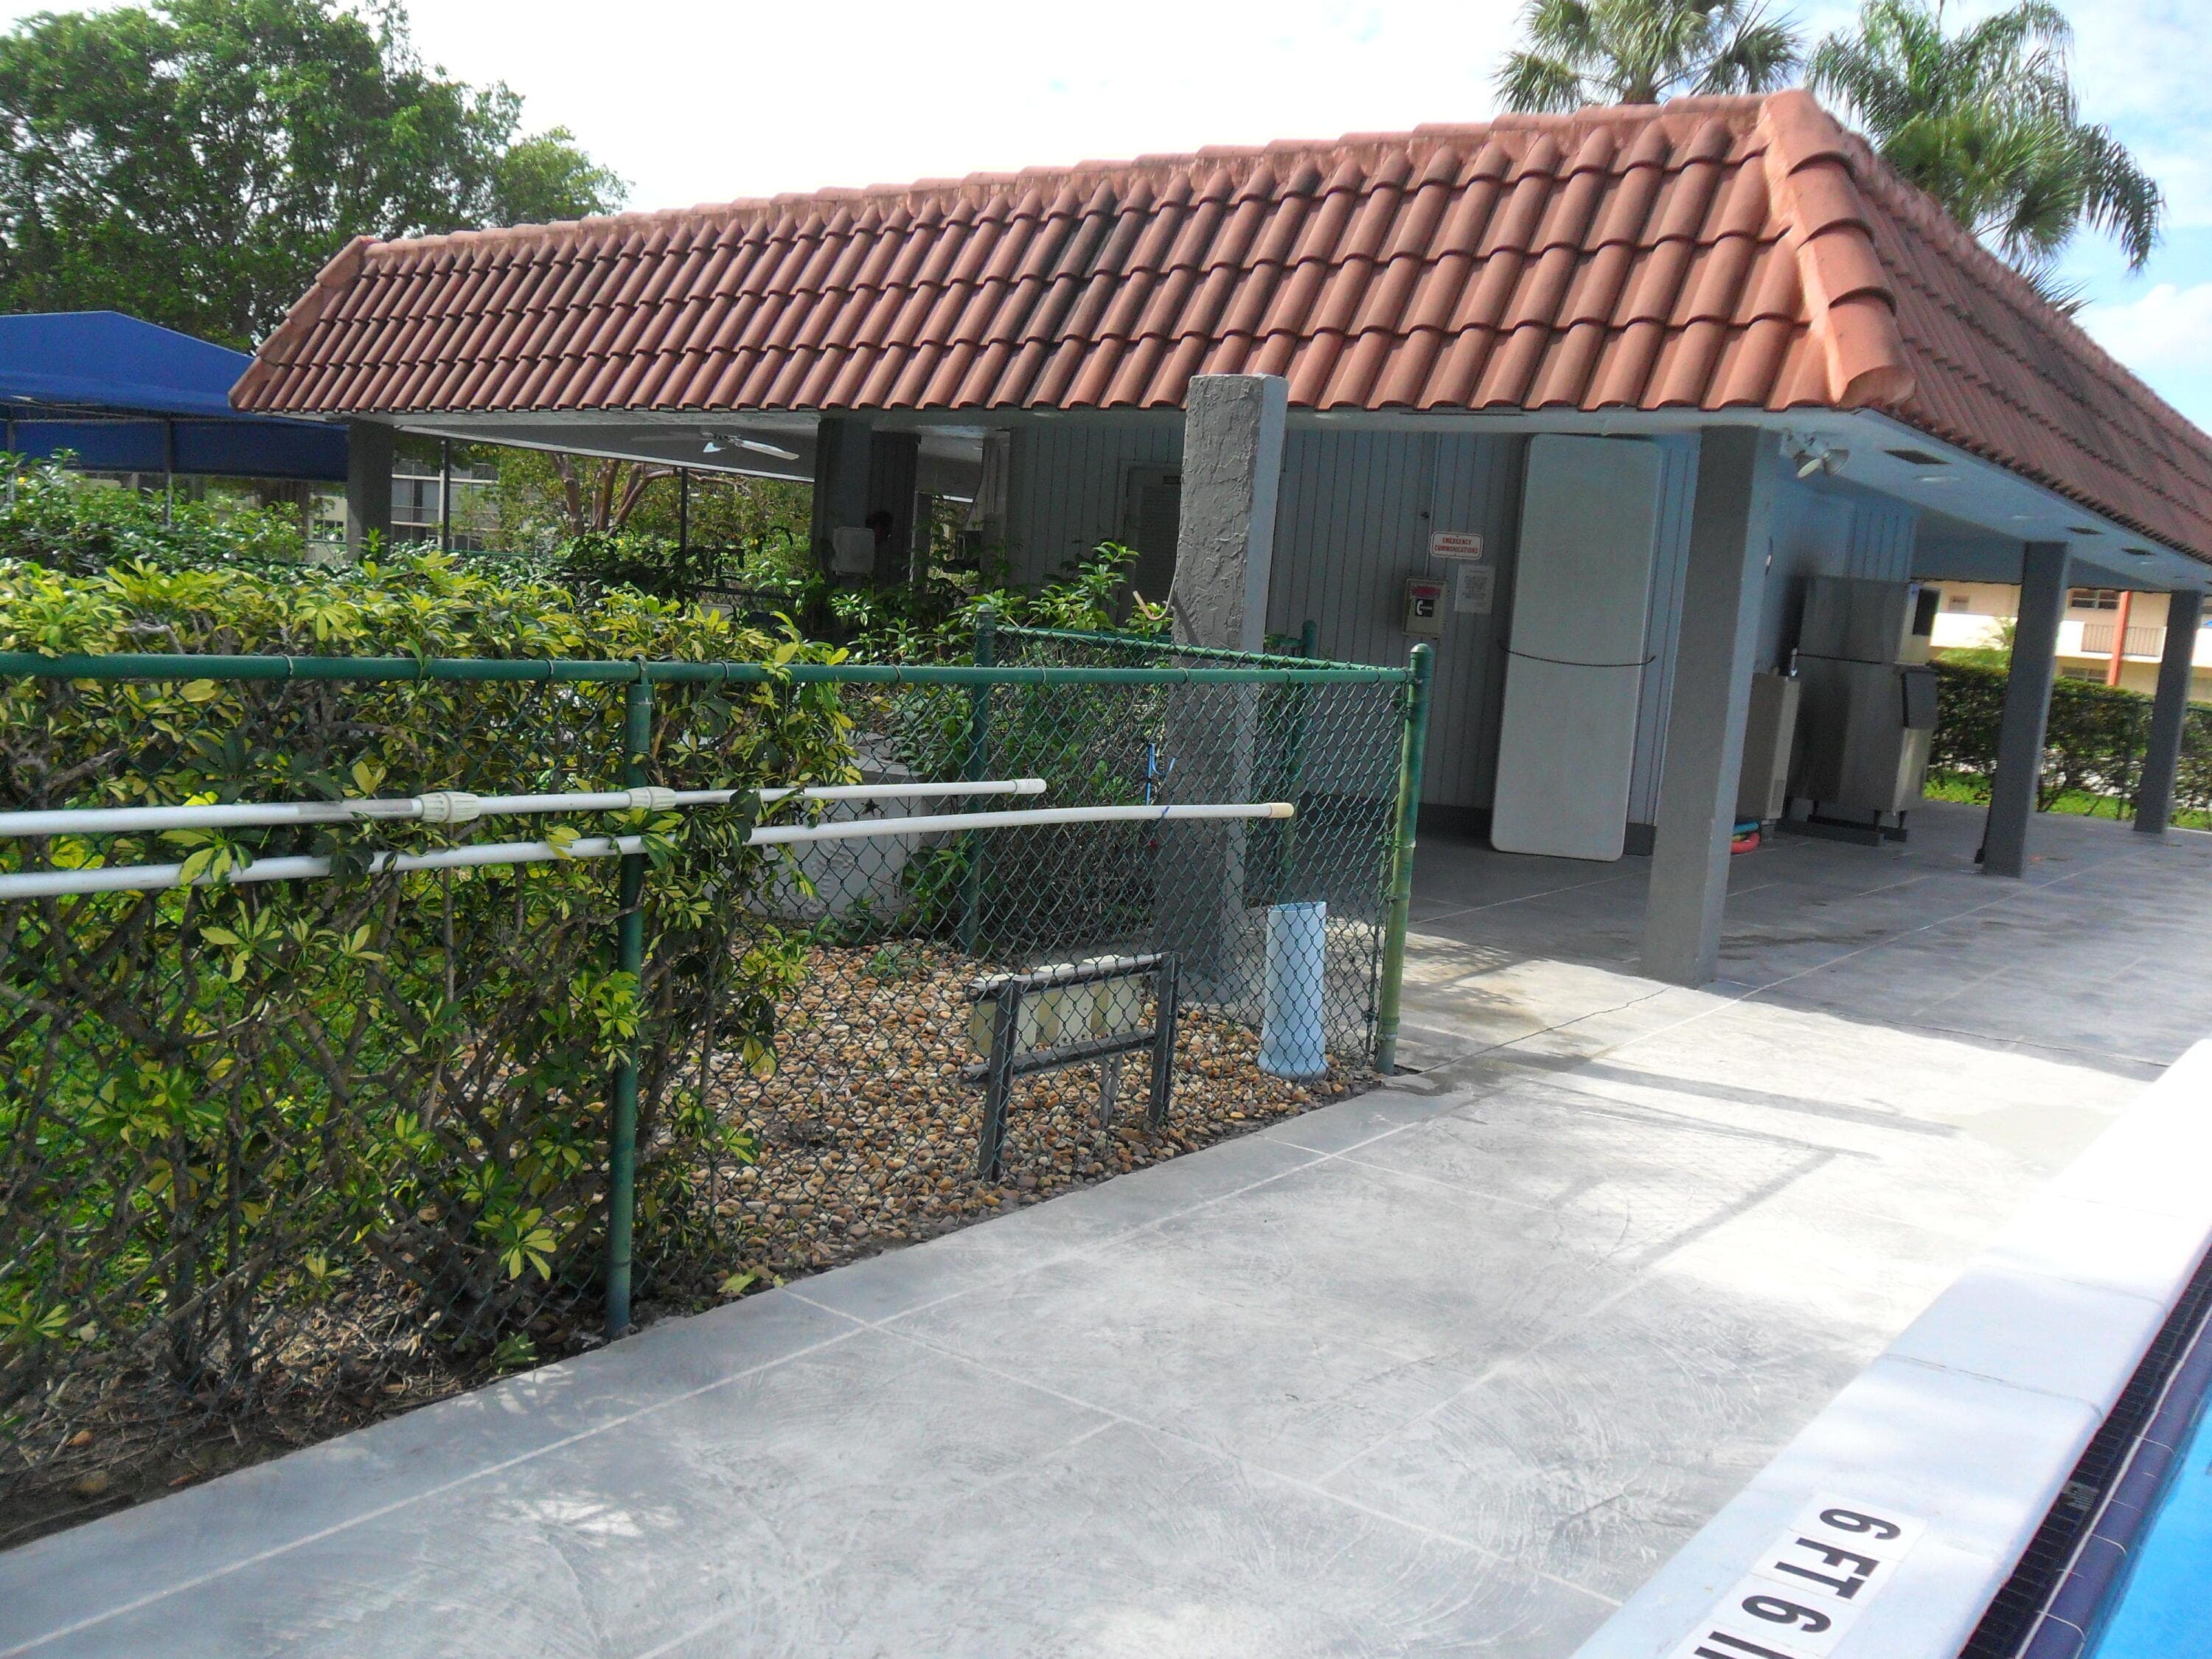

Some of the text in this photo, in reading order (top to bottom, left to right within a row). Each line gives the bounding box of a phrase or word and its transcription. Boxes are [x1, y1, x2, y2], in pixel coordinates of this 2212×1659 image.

[1434, 545, 1478, 554] COMMUNICATIONS
[1819, 1509, 1901, 1540] 6
[1775, 1537, 1879, 1599] FT
[1742, 1595, 1832, 1632] 6
